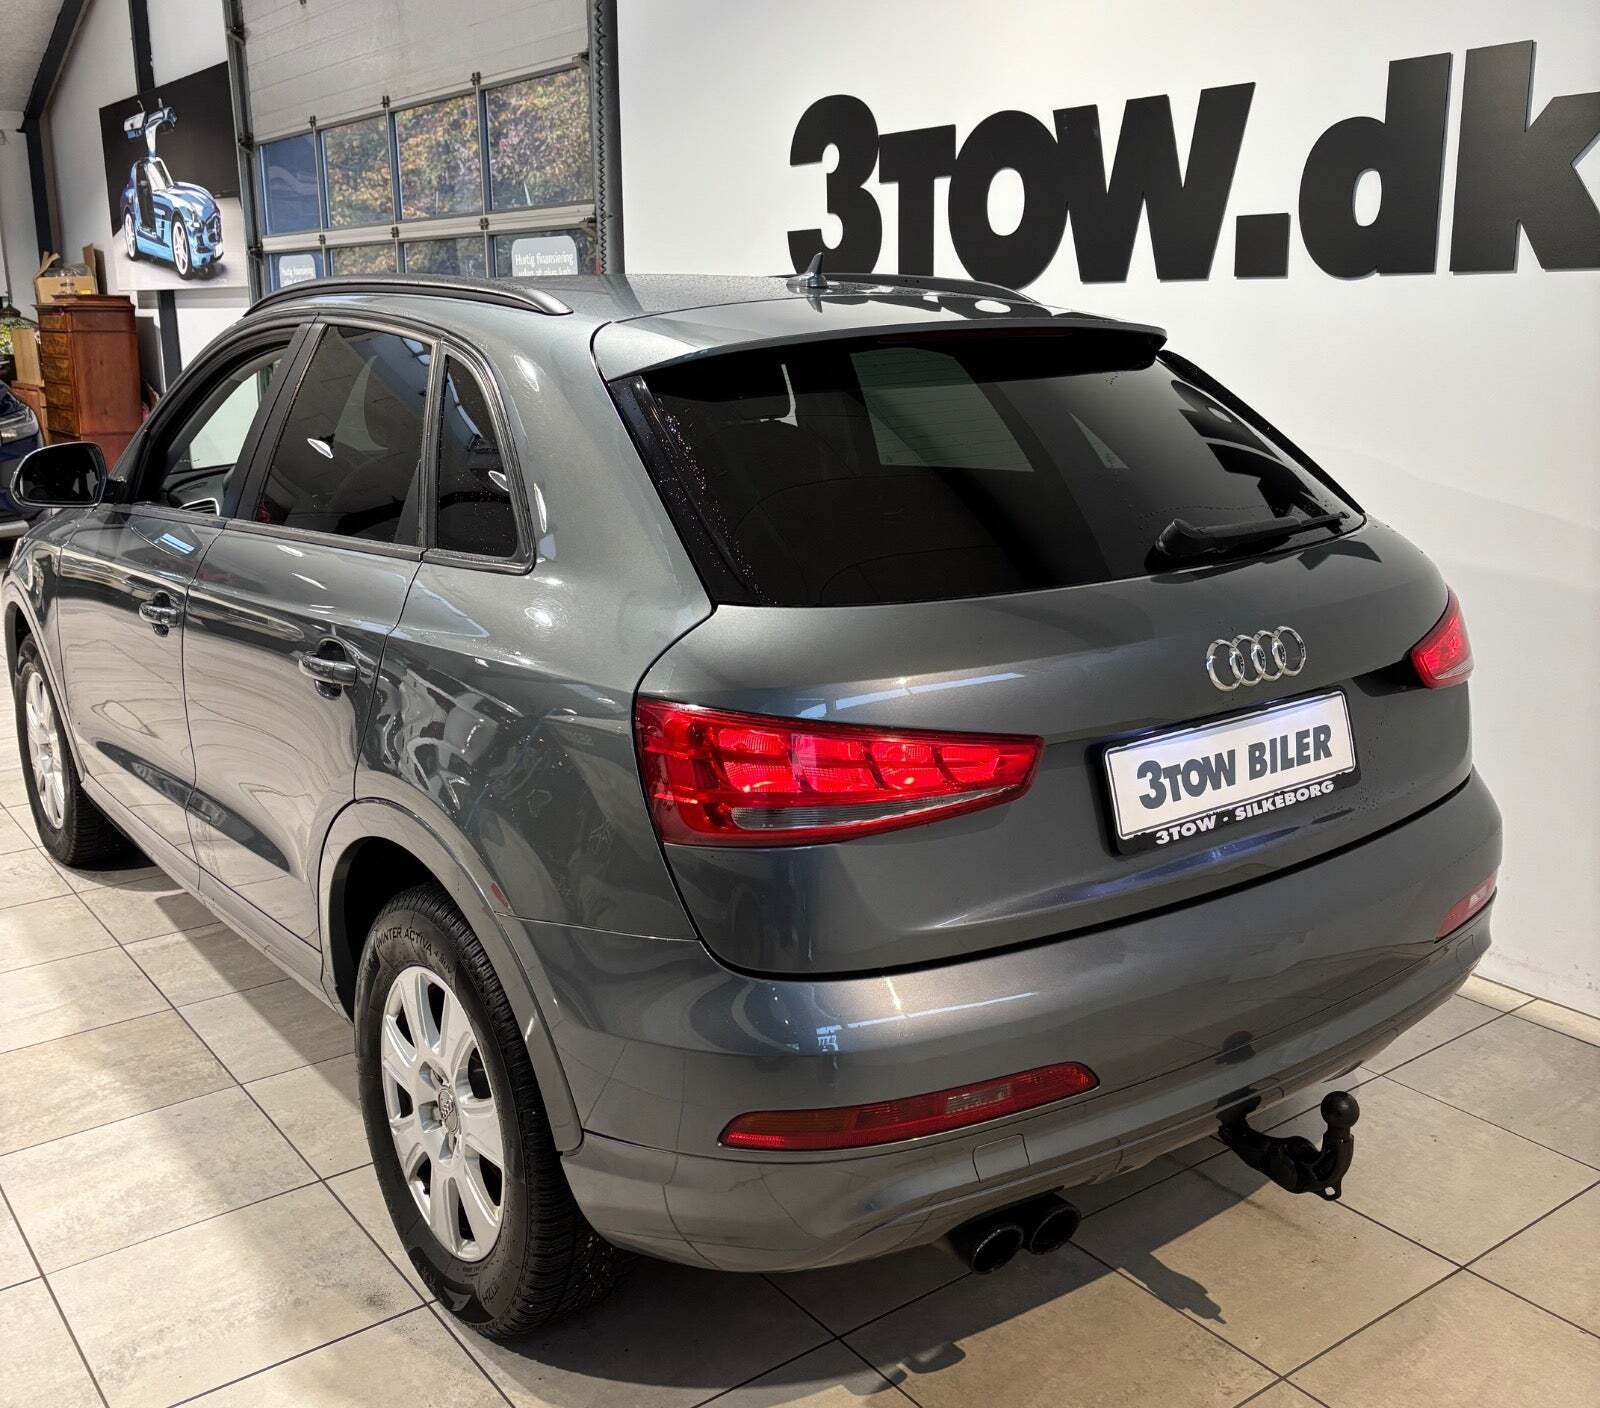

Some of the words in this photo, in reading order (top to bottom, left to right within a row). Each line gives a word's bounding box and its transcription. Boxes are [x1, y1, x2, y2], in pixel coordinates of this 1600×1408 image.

[787, 40, 1600, 285] 3TOW.dk
[514, 253, 535, 268] Hurtig
[536, 251, 574, 266] finansiering
[1137, 749, 1236, 809] 3TOW
[1248, 724, 1333, 781] BILER
[1155, 814, 1216, 845] 3TOW
[1234, 780, 1335, 821] SILKEBORG
[404, 928, 432, 956] ACTIVA
